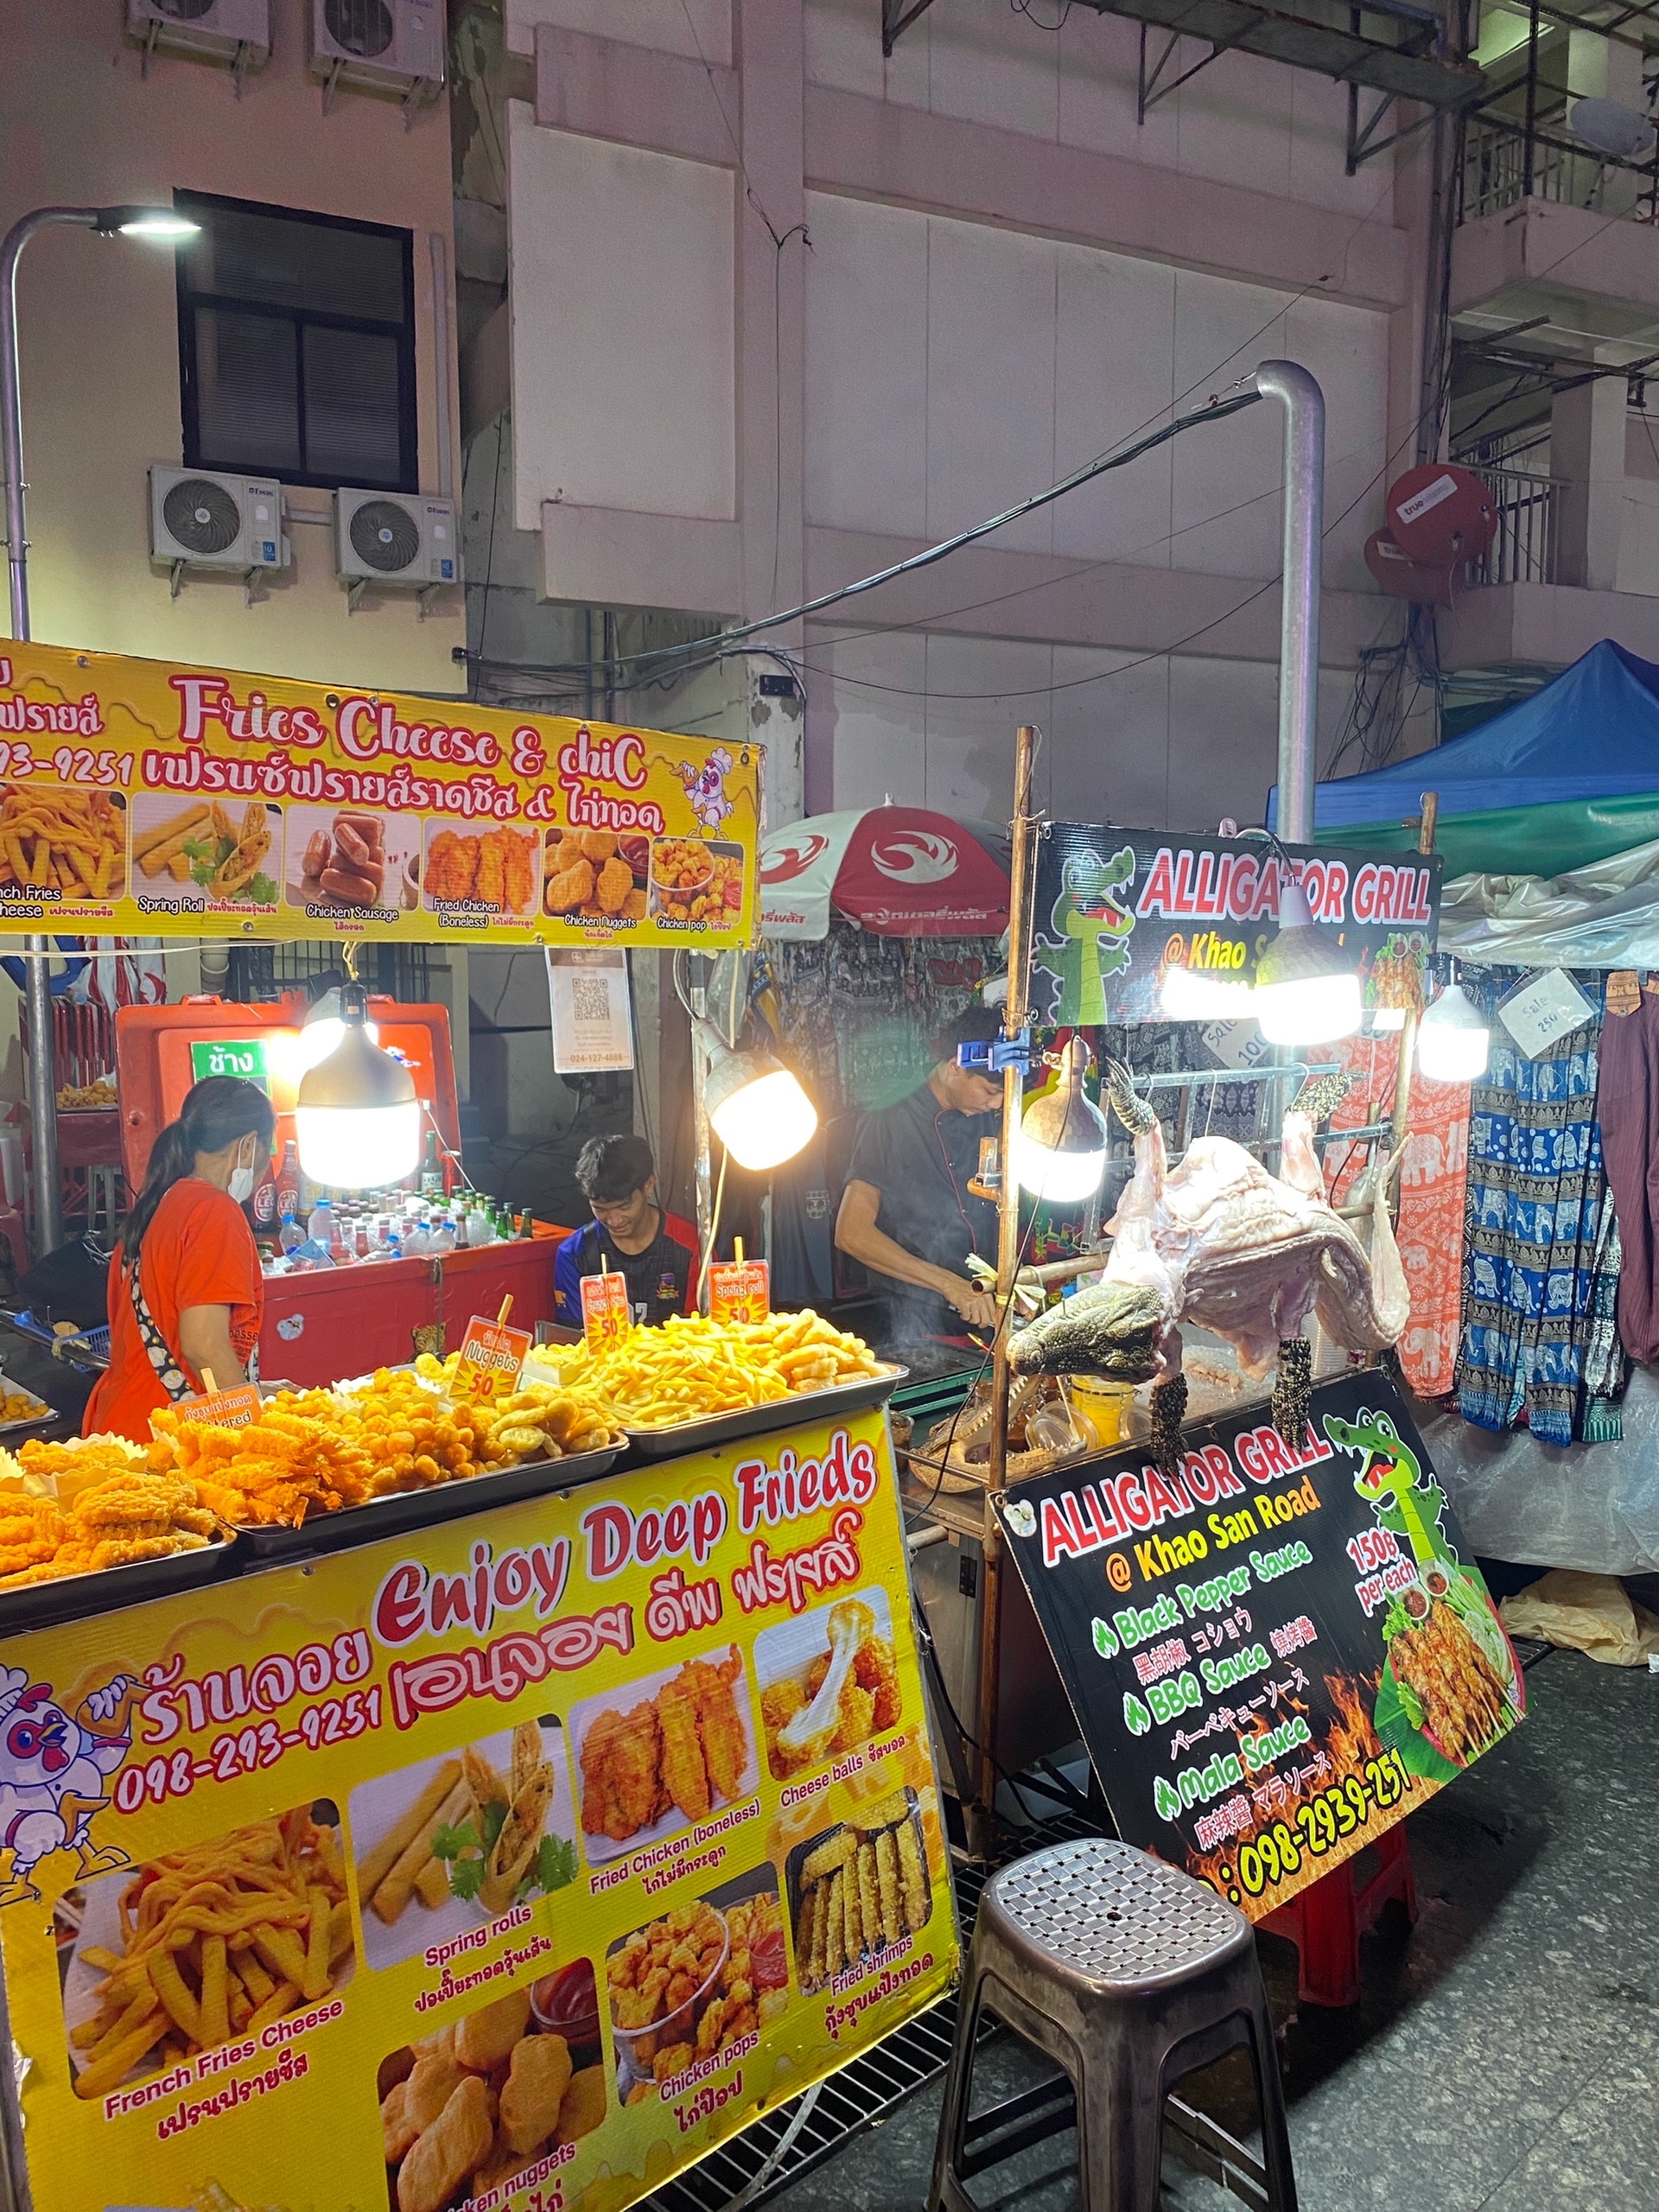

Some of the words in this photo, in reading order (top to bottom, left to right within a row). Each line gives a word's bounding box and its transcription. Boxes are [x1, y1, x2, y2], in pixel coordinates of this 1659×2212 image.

[170, 675, 327, 744] Fries
[337, 694, 499, 766] Cheese
[512, 727, 546, 777] &
[524, 783, 556, 821] &
[559, 776, 665, 836] ไก่ทอด
[25, 883, 62, 901] Fries
[138, 895, 180, 915] Spring
[181, 897, 205, 912] Roll
[306, 904, 351, 919] Chicken
[353, 906, 399, 924] Sausage
[432, 897, 460, 912] Fried
[461, 899, 499, 912] Chicken
[1352, 863, 1431, 925] GRILL
[438, 913, 489, 929] (Boneless)
[564, 913, 599, 927] Chicken
[601, 916, 637, 931] Nuggets
[657, 917, 689, 929] Chicken
[690, 920, 707, 933] pop
[1187, 931, 1247, 969] Khao
[1522, 995, 1549, 1019] Sale
[209, 1046, 253, 1072] ช้าง
[279, 1200, 296, 1209] LEO
[716, 1281, 746, 1299] Spring
[748, 1279, 764, 1294] roll
[465, 1339, 519, 1373] Nuggets
[372, 1535, 570, 1649] Enjoy
[580, 1488, 728, 1582] Deep
[733, 1430, 876, 1535] Frieds
[1105, 1552, 1132, 1592] @
[1134, 1529, 1207, 1582] Khao
[1208, 1508, 1258, 1549] San
[1254, 1474, 1321, 1530] Road
[645, 1566, 721, 1641] ดีพ
[1113, 1594, 1182, 1649] Black
[1176, 1567, 1250, 1617] Pepper
[1249, 1541, 1313, 1582] Sauce
[1355, 1574, 1385, 1617] per
[1383, 1553, 1418, 1595] each
[1192, 1607, 1253, 1653] コショウ
[140, 1628, 372, 1745] ร้านจอย
[1133, 1638, 1192, 1686] 黑胡椒
[1146, 1671, 1203, 1726] BBQ
[1200, 1643, 1272, 1694] Sauce
[113, 1685, 382, 1815] 098-293-9251
[868, 1736, 906, 1763] ชีสบอล
[1178, 1754, 1242, 1808] Mala
[1241, 1716, 1312, 1772] Sauce
[780, 1774, 830, 1808] Cheese
[832, 1756, 863, 1782] balls
[1253, 1751, 1332, 1812] マラソース
[590, 1861, 632, 1896] Fried
[632, 1836, 690, 1873] Chicken
[693, 1799, 760, 1846] (boneless)
[1194, 1794, 1253, 1851] 麻辣醬
[425, 1928, 487, 1967] Spring
[492, 1906, 532, 1937] rolls
[831, 1966, 864, 1997] Fried
[867, 1936, 912, 1974] shrimps
[104, 2067, 191, 2122] French
[195, 2039, 257, 2081] Fries
[261, 1999, 344, 2050] Cheese
[661, 2053, 721, 2101] Chicken
[723, 2031, 759, 2068] pops
[503, 2143, 575, 2197] nuggets
